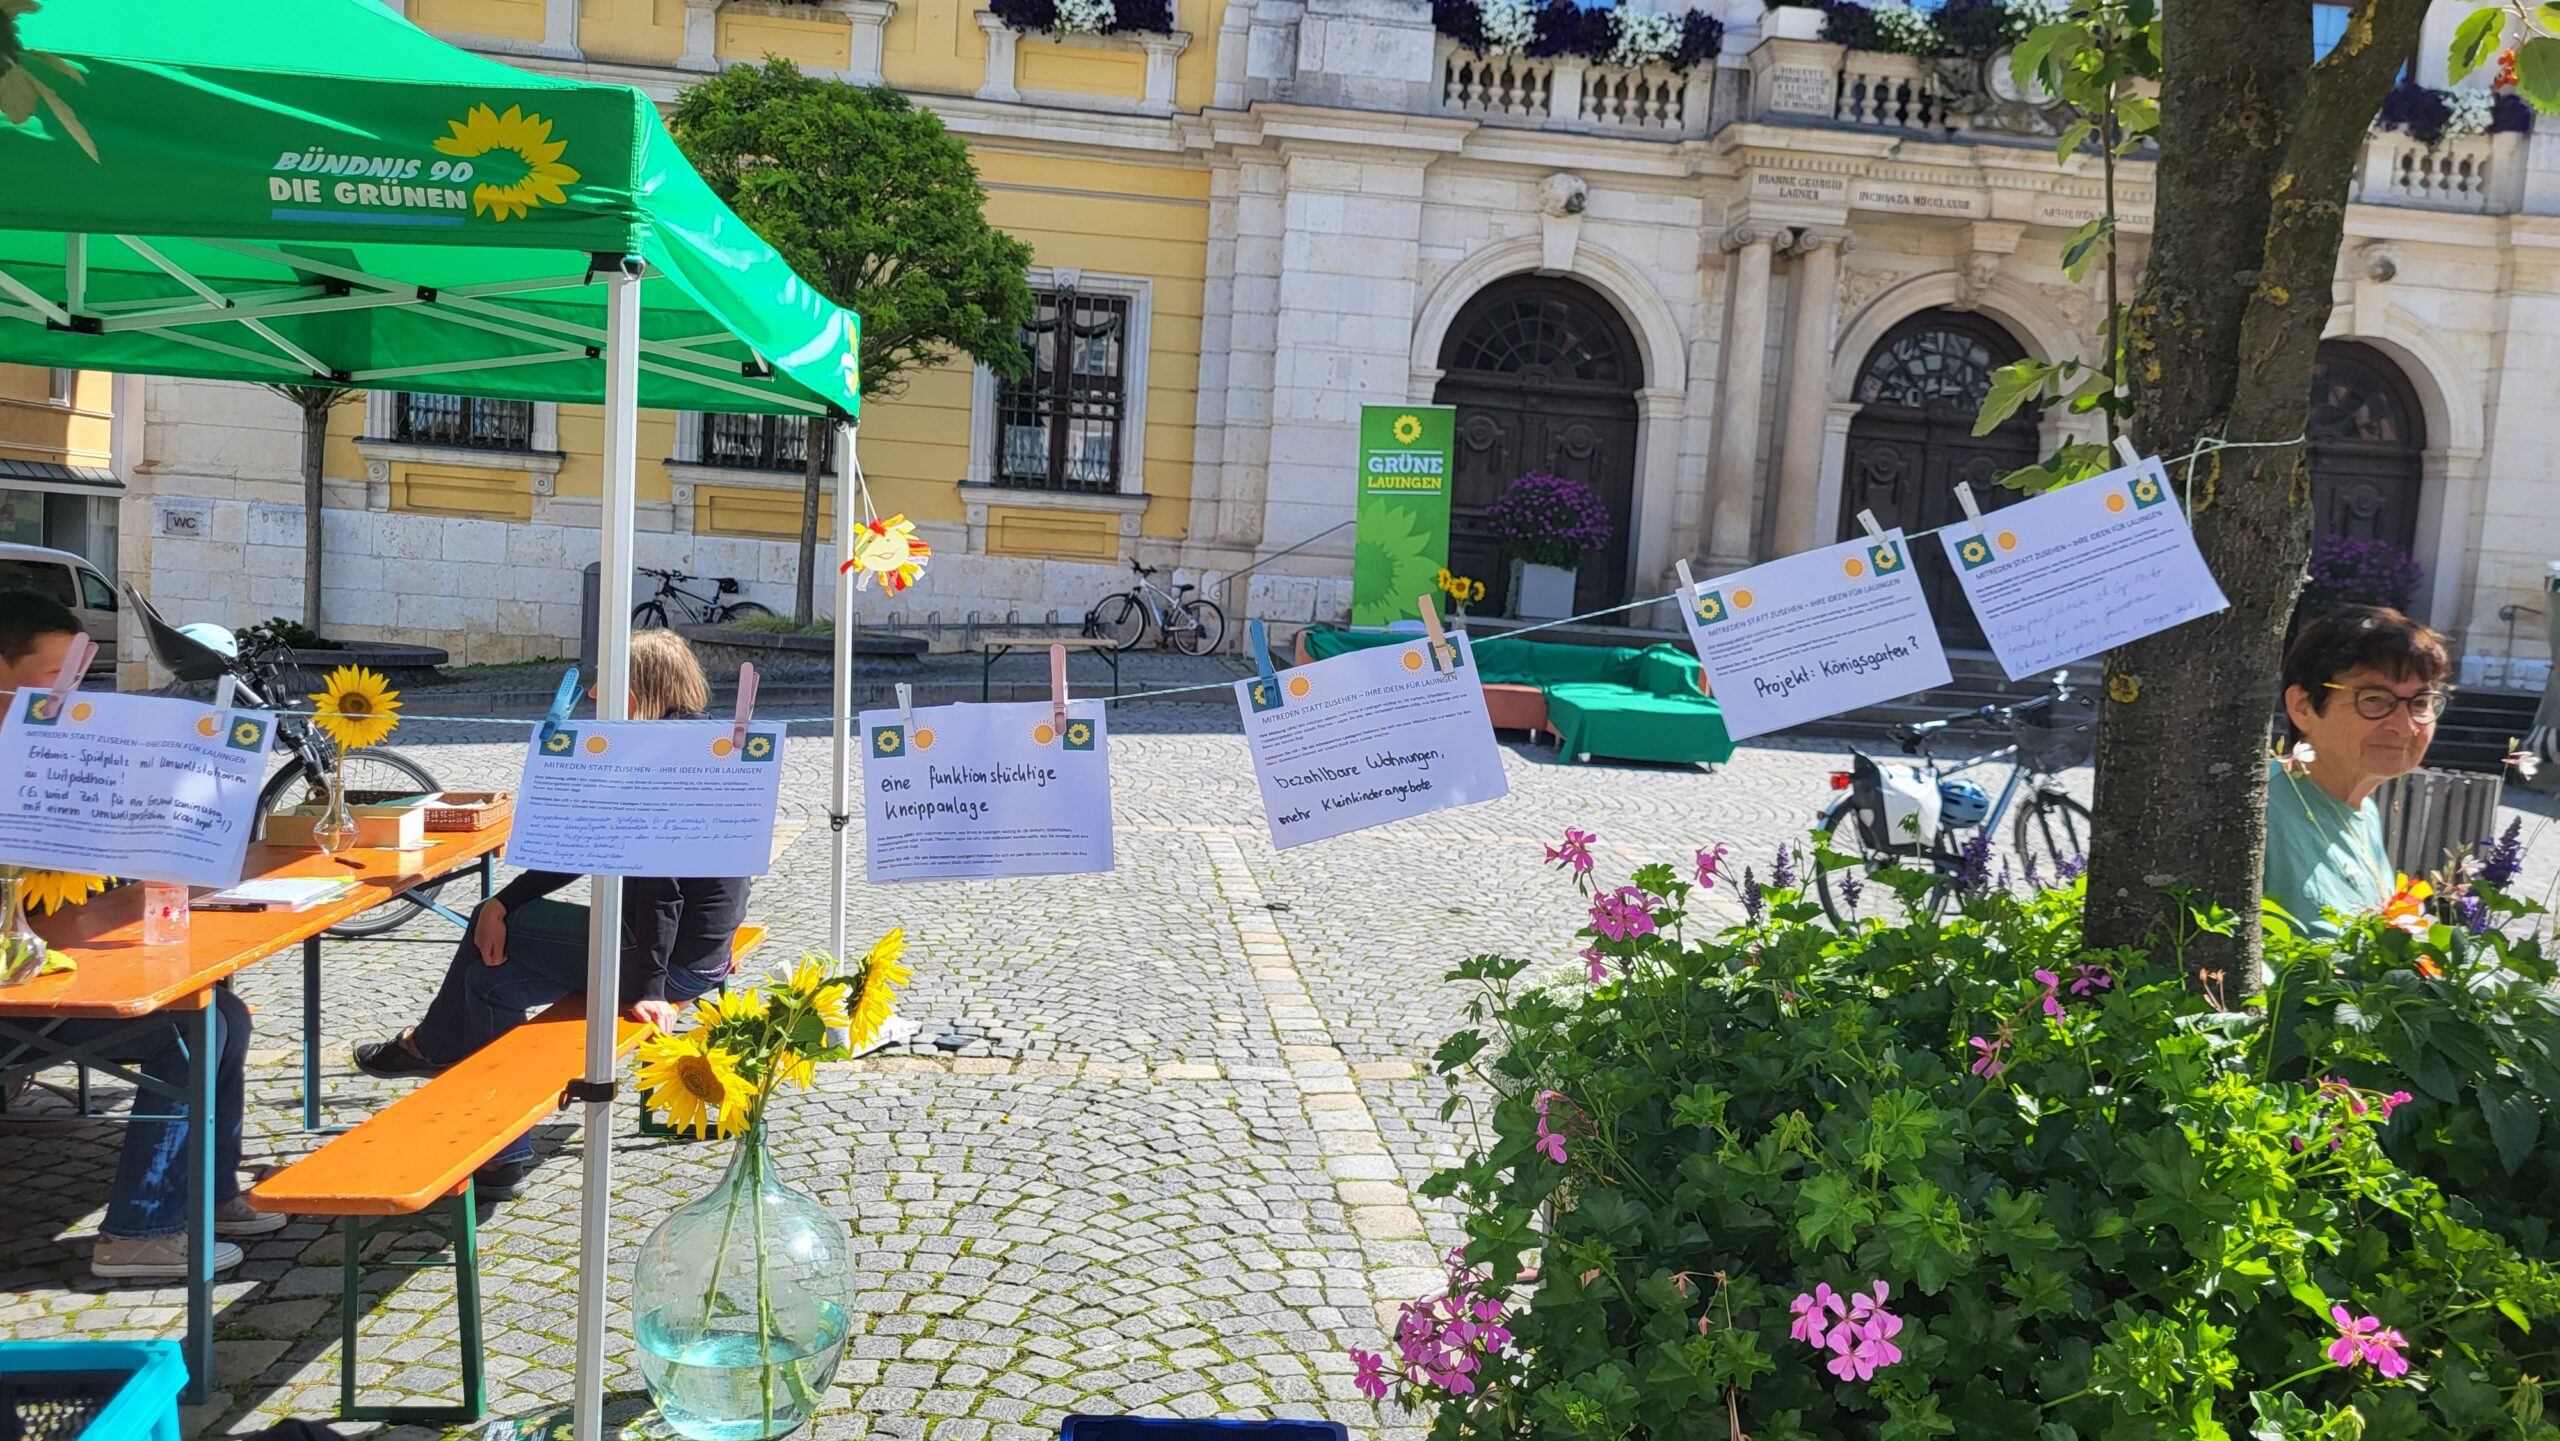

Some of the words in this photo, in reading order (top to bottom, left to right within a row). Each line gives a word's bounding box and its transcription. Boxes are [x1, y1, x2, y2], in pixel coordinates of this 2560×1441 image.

[272, 146, 421, 179] BÜNDNIS
[428, 160, 474, 183] 90
[269, 176, 322, 203] DIE
[334, 178, 468, 209] GRÜNEN
[1368, 453, 1444, 474] GRÜNE
[1367, 476, 1442, 489] LAUINGEN
[173, 517, 197, 529] WC
[1976, 563, 2013, 580] MITREDEN
[2013, 555, 2035, 569] STATT
[2036, 544, 2068, 562] ZUSEHEN
[2073, 534, 2089, 547] IHRE
[2090, 529, 2111, 542] IDEEN
[2112, 522, 2126, 536] FÜR
[2127, 509, 2163, 529] LAUINGEN
[1708, 621, 1746, 638] MITREDEN
[1747, 613, 1769, 627] STATT
[1770, 603, 1804, 619] ZUSEHEN
[1810, 597, 1826, 609] IHRE
[1827, 592, 1848, 604] IDEEN
[1849, 587, 1863, 600] FÜR
[1864, 578, 1900, 594] LAUINGEN
[1753, 666, 1815, 698] Projekt:
[1261, 709, 1300, 725] MITREDEN
[1301, 702, 1323, 715] STATT
[1324, 693, 1357, 710] ZUSEHEN
[1365, 687, 1381, 698] IHRE
[1383, 684, 1405, 695] IDEEN
[1406, 679, 1421, 691] FÜR
[1421, 674, 1458, 688] LAUINGEN
[70, 732, 96, 741] STATT
[97, 735, 138, 747] ZUSEHEN
[183, 742, 201, 753] FÜR
[202, 748, 248, 764] LAUINGEN
[544, 761, 586, 771] MITREDEN
[587, 763, 613, 773] STATT
[614, 765, 650, 774] ZUSEHEN
[659, 766, 677, 774] IHRE
[679, 766, 703, 775] IDEEN
[704, 764, 720, 775] FÜR
[722, 766, 762, 775] LAUINGEN
[881, 774, 912, 793] eine
[929, 761, 1057, 790] funktionstüchtige
[1273, 764, 1361, 789] bezahlbare
[1365, 748, 1446, 770] Wohnungen,
[47, 803, 81, 816] einem
[79, 790, 99, 803] Zeit
[1278, 808, 1312, 825] mehr
[1321, 778, 1433, 812] Kleinkinderangebote
